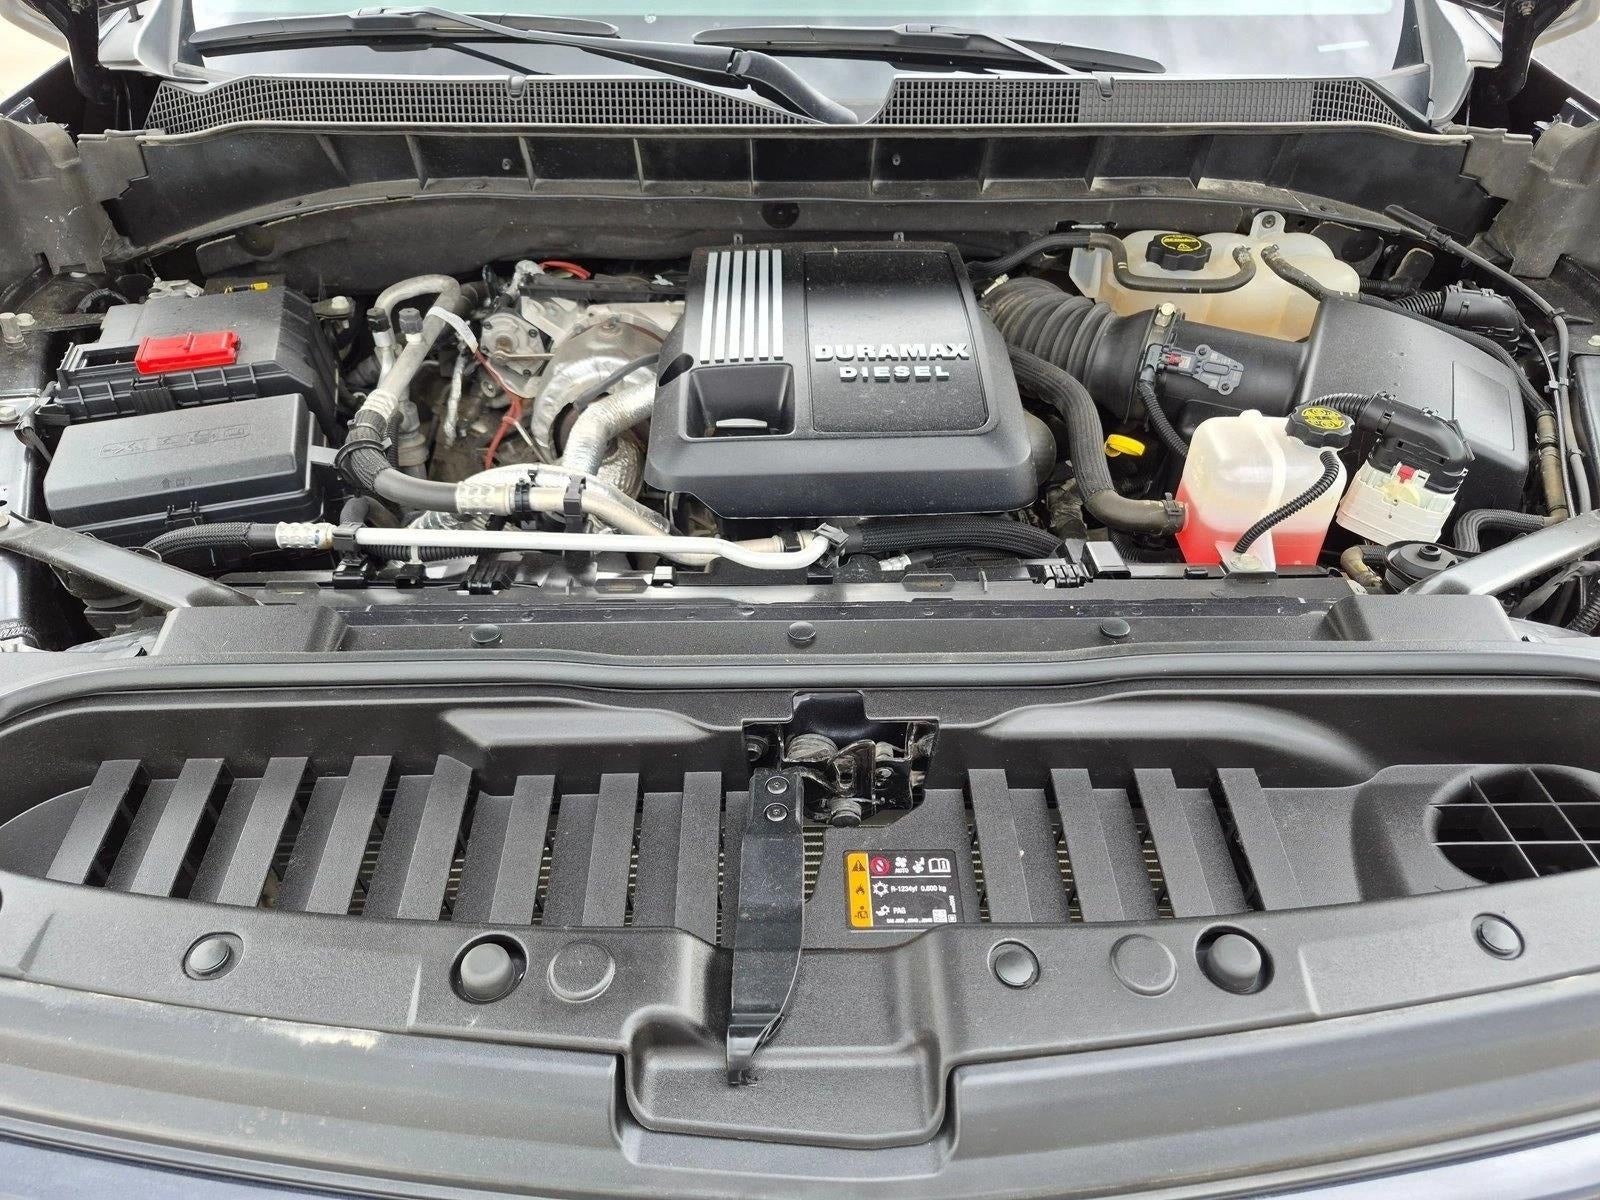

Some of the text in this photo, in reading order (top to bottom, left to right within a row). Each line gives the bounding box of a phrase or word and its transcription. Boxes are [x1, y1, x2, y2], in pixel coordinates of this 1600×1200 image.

[815, 343, 970, 361] DURAMAX
[839, 365, 950, 381] DIESEL
[890, 885, 918, 894] R-1234yf
